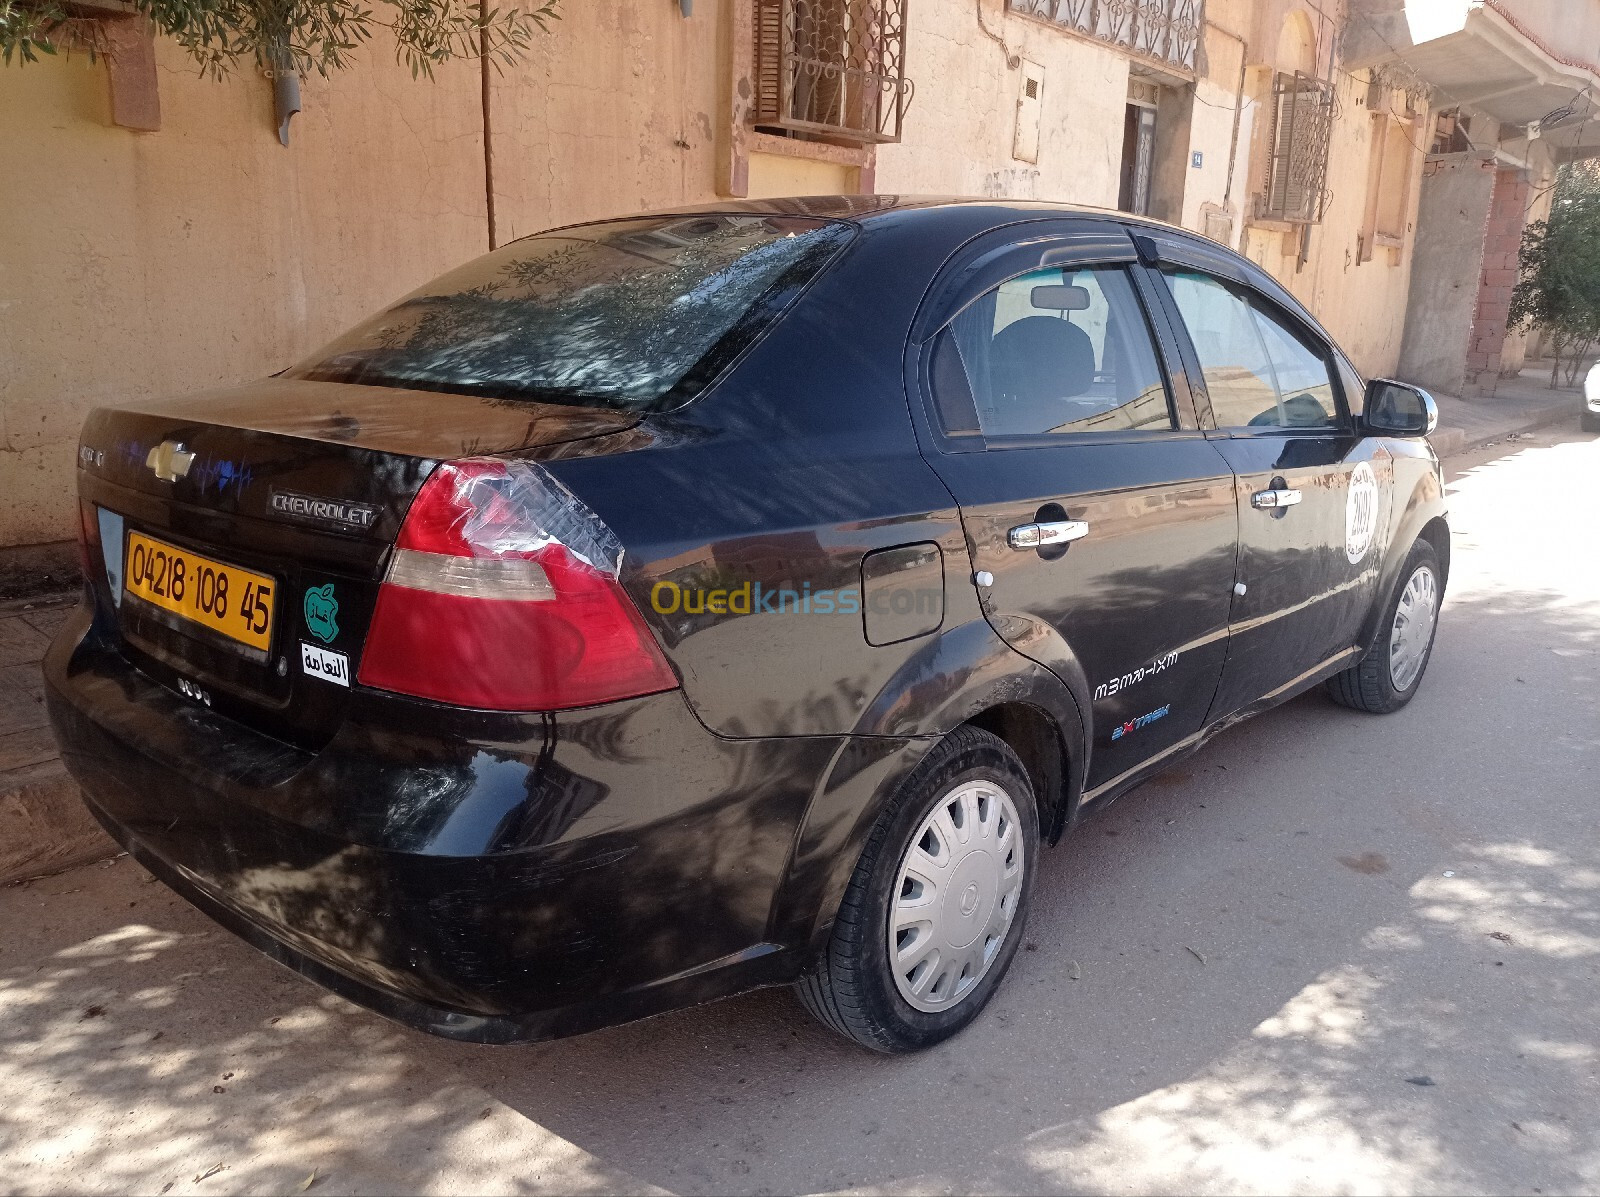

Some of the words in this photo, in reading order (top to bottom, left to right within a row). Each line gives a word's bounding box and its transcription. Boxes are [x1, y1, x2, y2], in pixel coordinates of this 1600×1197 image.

[272, 495, 373, 525] CHEVROLET
[240, 581, 271, 635] 45
[304, 647, 347, 681] النعامة
